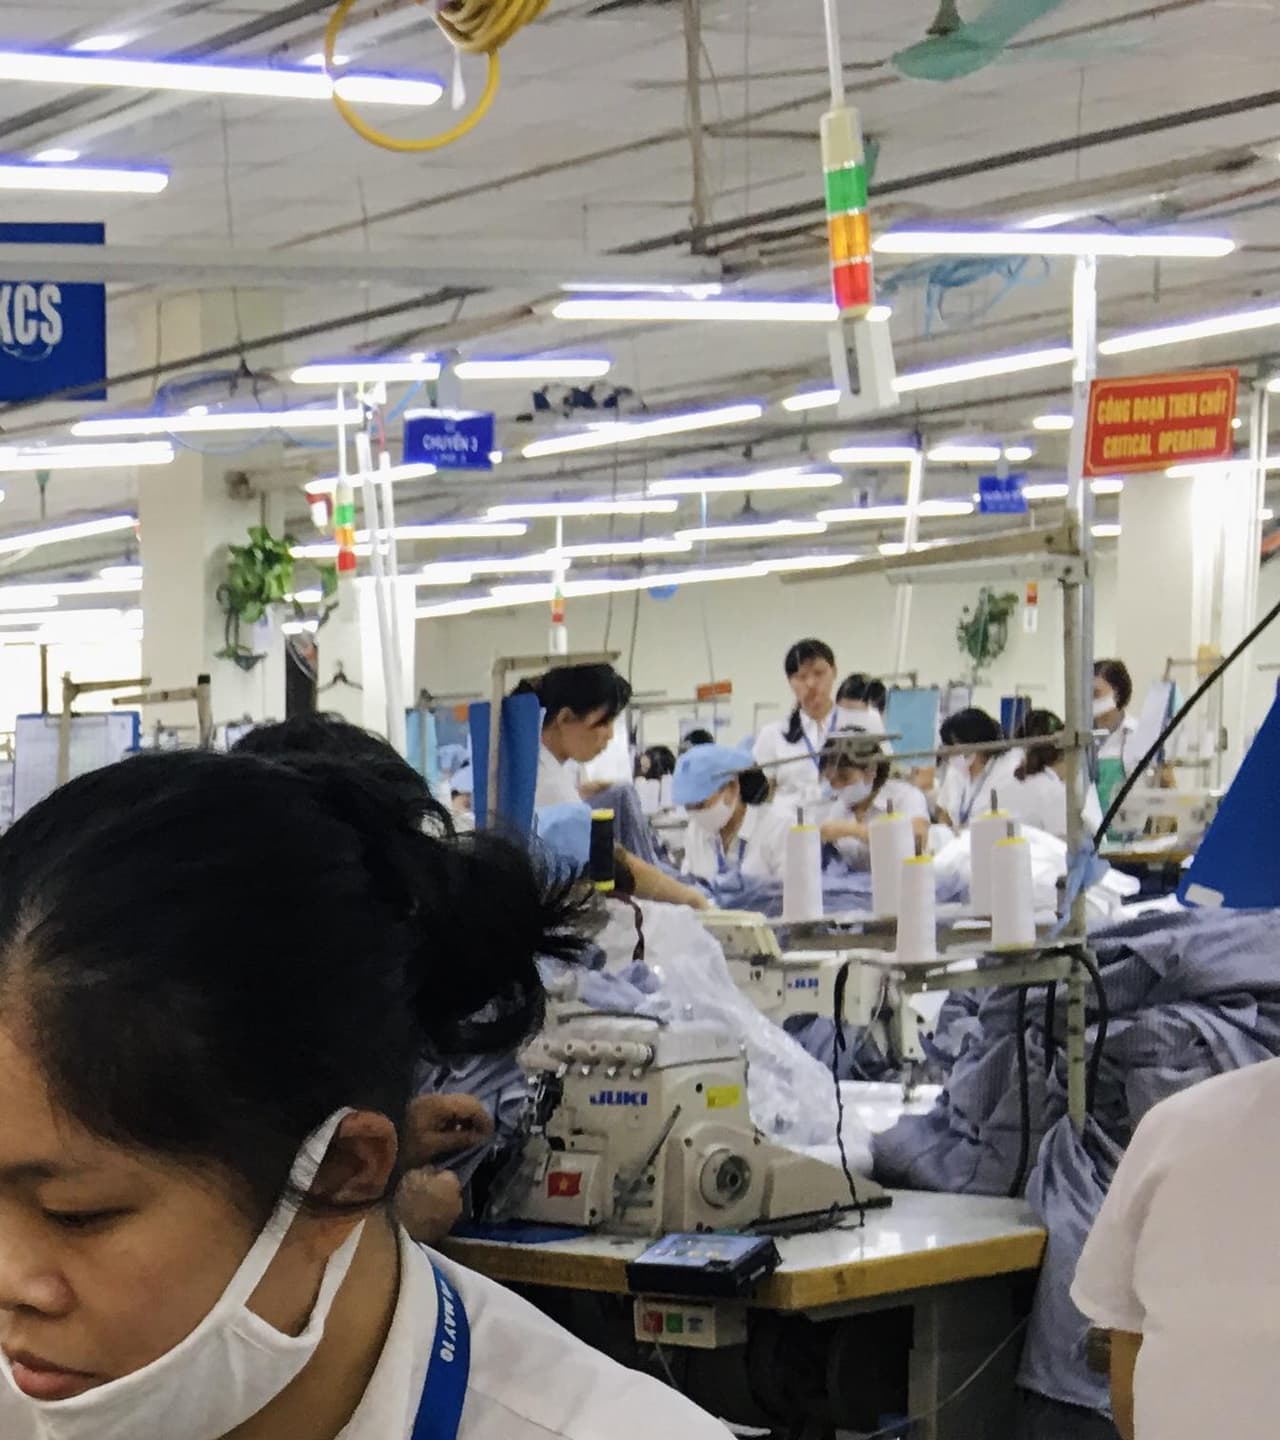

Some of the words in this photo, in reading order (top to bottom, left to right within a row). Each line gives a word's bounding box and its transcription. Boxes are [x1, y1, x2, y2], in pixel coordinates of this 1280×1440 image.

[1103, 432, 1152, 459] CRITICAL
[1158, 426, 1217, 454] OPERATION
[589, 1090, 648, 1106] JUKI
